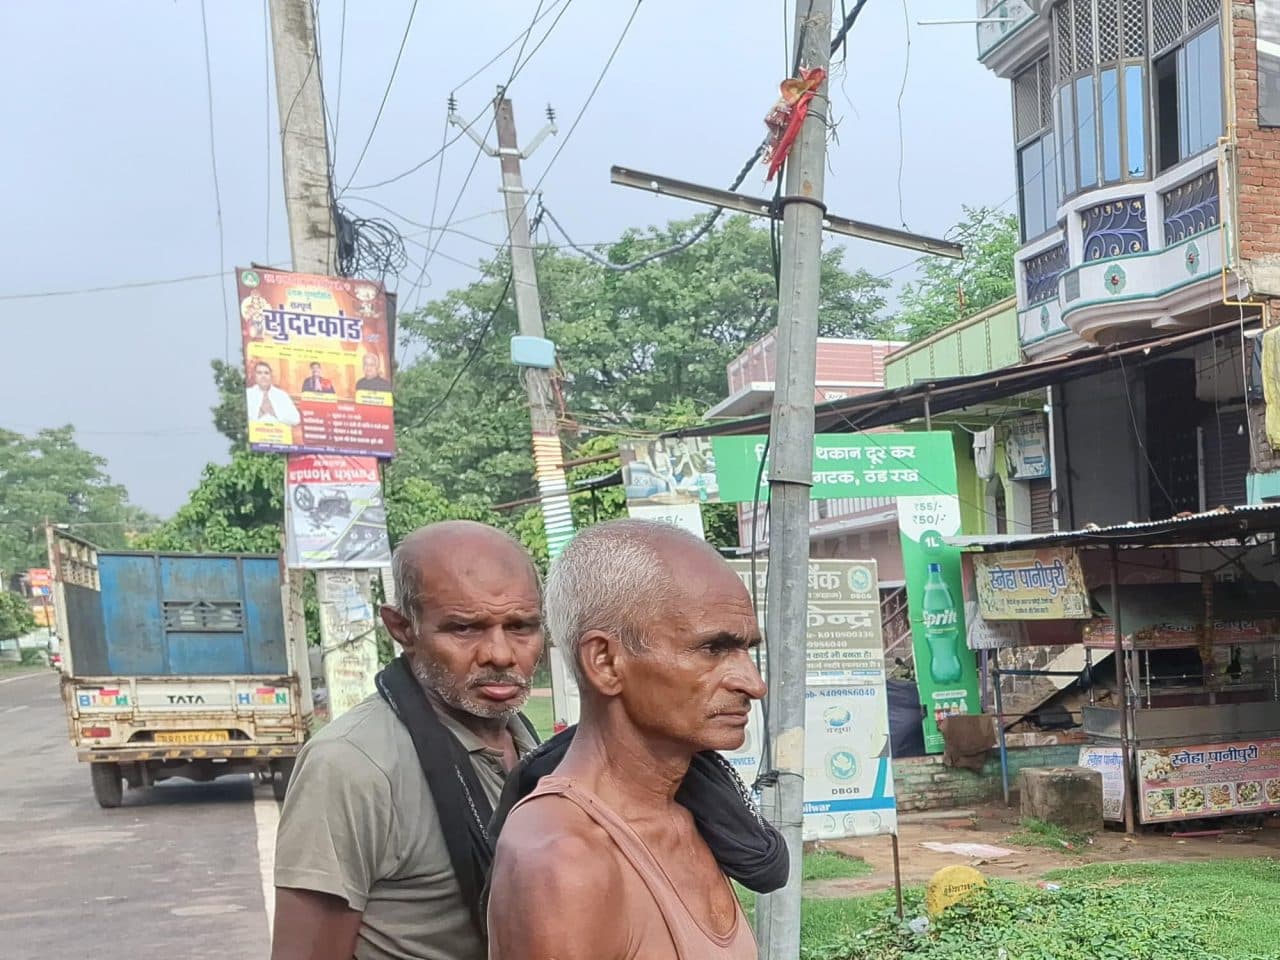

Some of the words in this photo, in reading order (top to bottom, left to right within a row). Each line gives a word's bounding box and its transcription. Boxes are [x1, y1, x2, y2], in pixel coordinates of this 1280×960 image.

[262, 304, 364, 342] सुंदरकांड
[815, 445, 862, 460] थकान
[864, 445, 887, 465] दूर
[889, 445, 917, 459] कर
[290, 468, 331, 482] Honda
[863, 465, 888, 483] ठंड
[889, 469, 919, 482] रख
[1018, 559, 1066, 595] पानीपुरी
[166, 695, 205, 704] TATA
[728, 756, 756, 766] ERVICES
[1171, 751, 1205, 767] स्नेहा
[1208, 745, 1259, 764] पानीपुरी
[832, 787, 860, 795] DBGB
